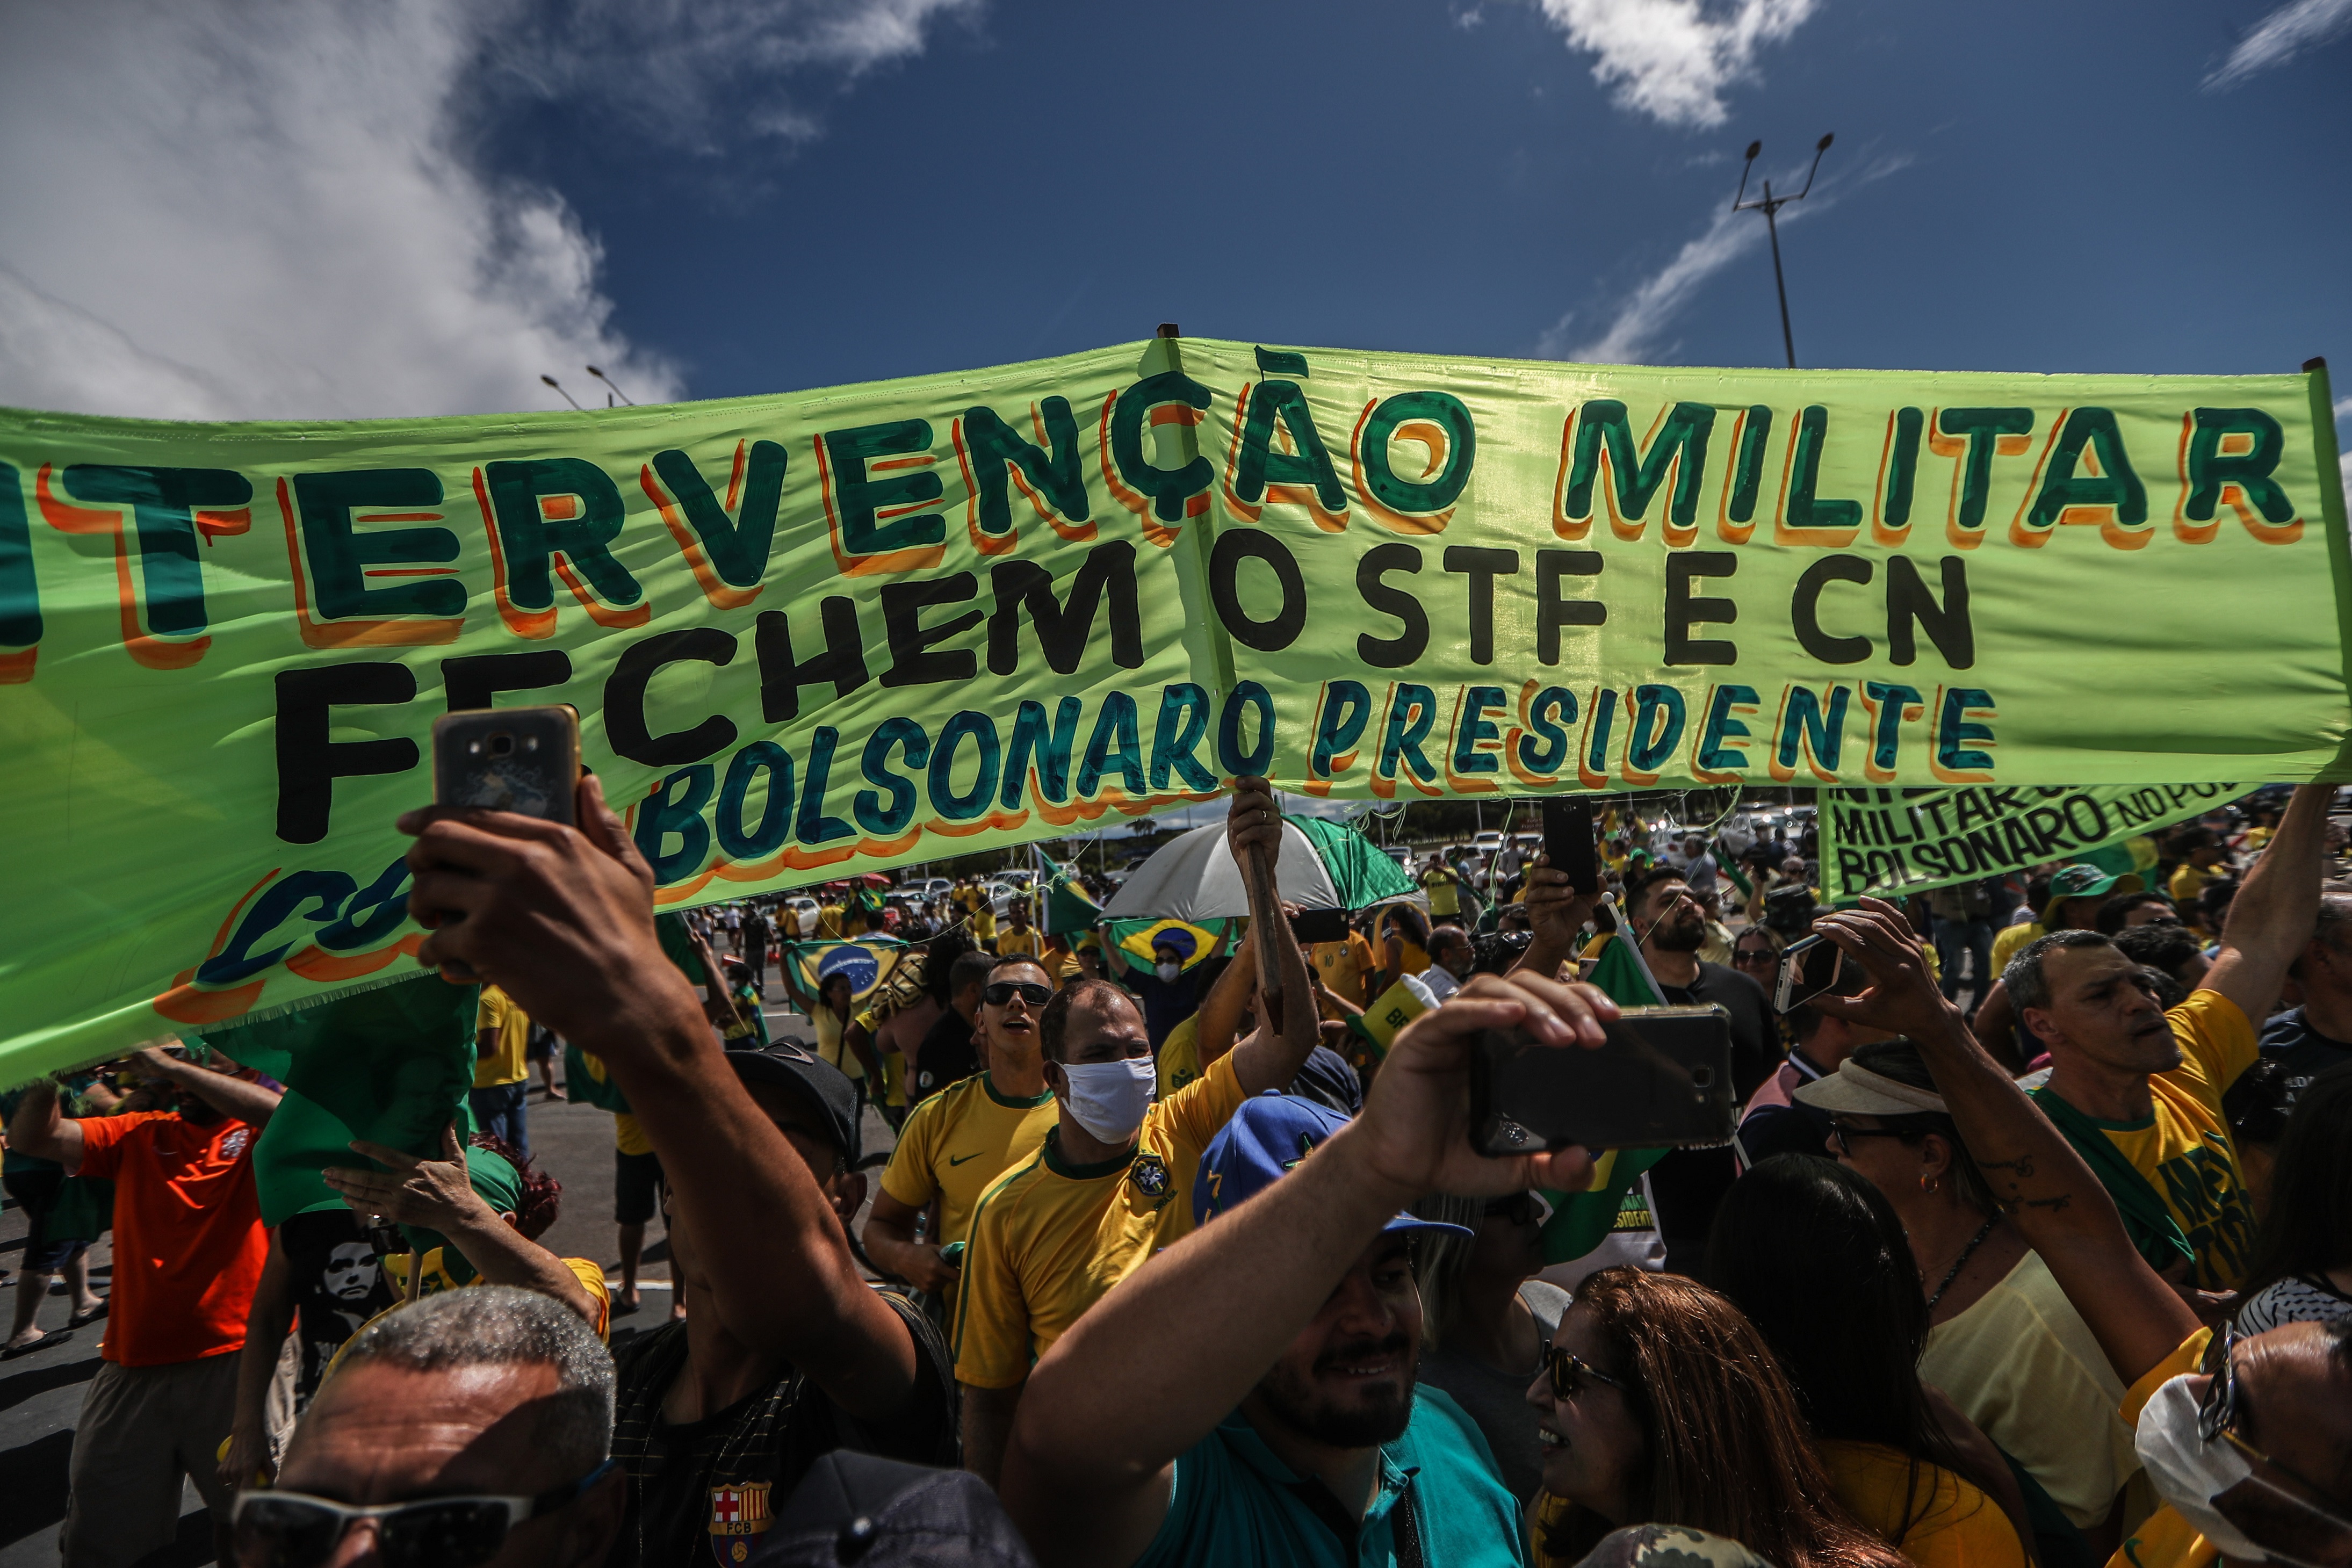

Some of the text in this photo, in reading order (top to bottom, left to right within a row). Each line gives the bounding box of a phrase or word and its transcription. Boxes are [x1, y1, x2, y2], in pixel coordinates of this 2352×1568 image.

[1561, 399, 2297, 532] MILITAR
[1208, 528, 1307, 652] O
[1355, 543, 1607, 668] STF
[1663, 551, 1737, 666] E
[1791, 554, 1975, 670] CN
[634, 679, 1276, 886] BOLSONARO
[1310, 679, 1996, 787] PRESIDENTE
[1832, 787, 2028, 846] MILITAR
[1837, 795, 2109, 895] BOLSONARO
[2116, 788, 2166, 827] NO
[1325, 955, 1334, 967] 10
[1153, 1189, 1179, 1212] BRASIL
[727, 1522, 752, 1535] FCB
